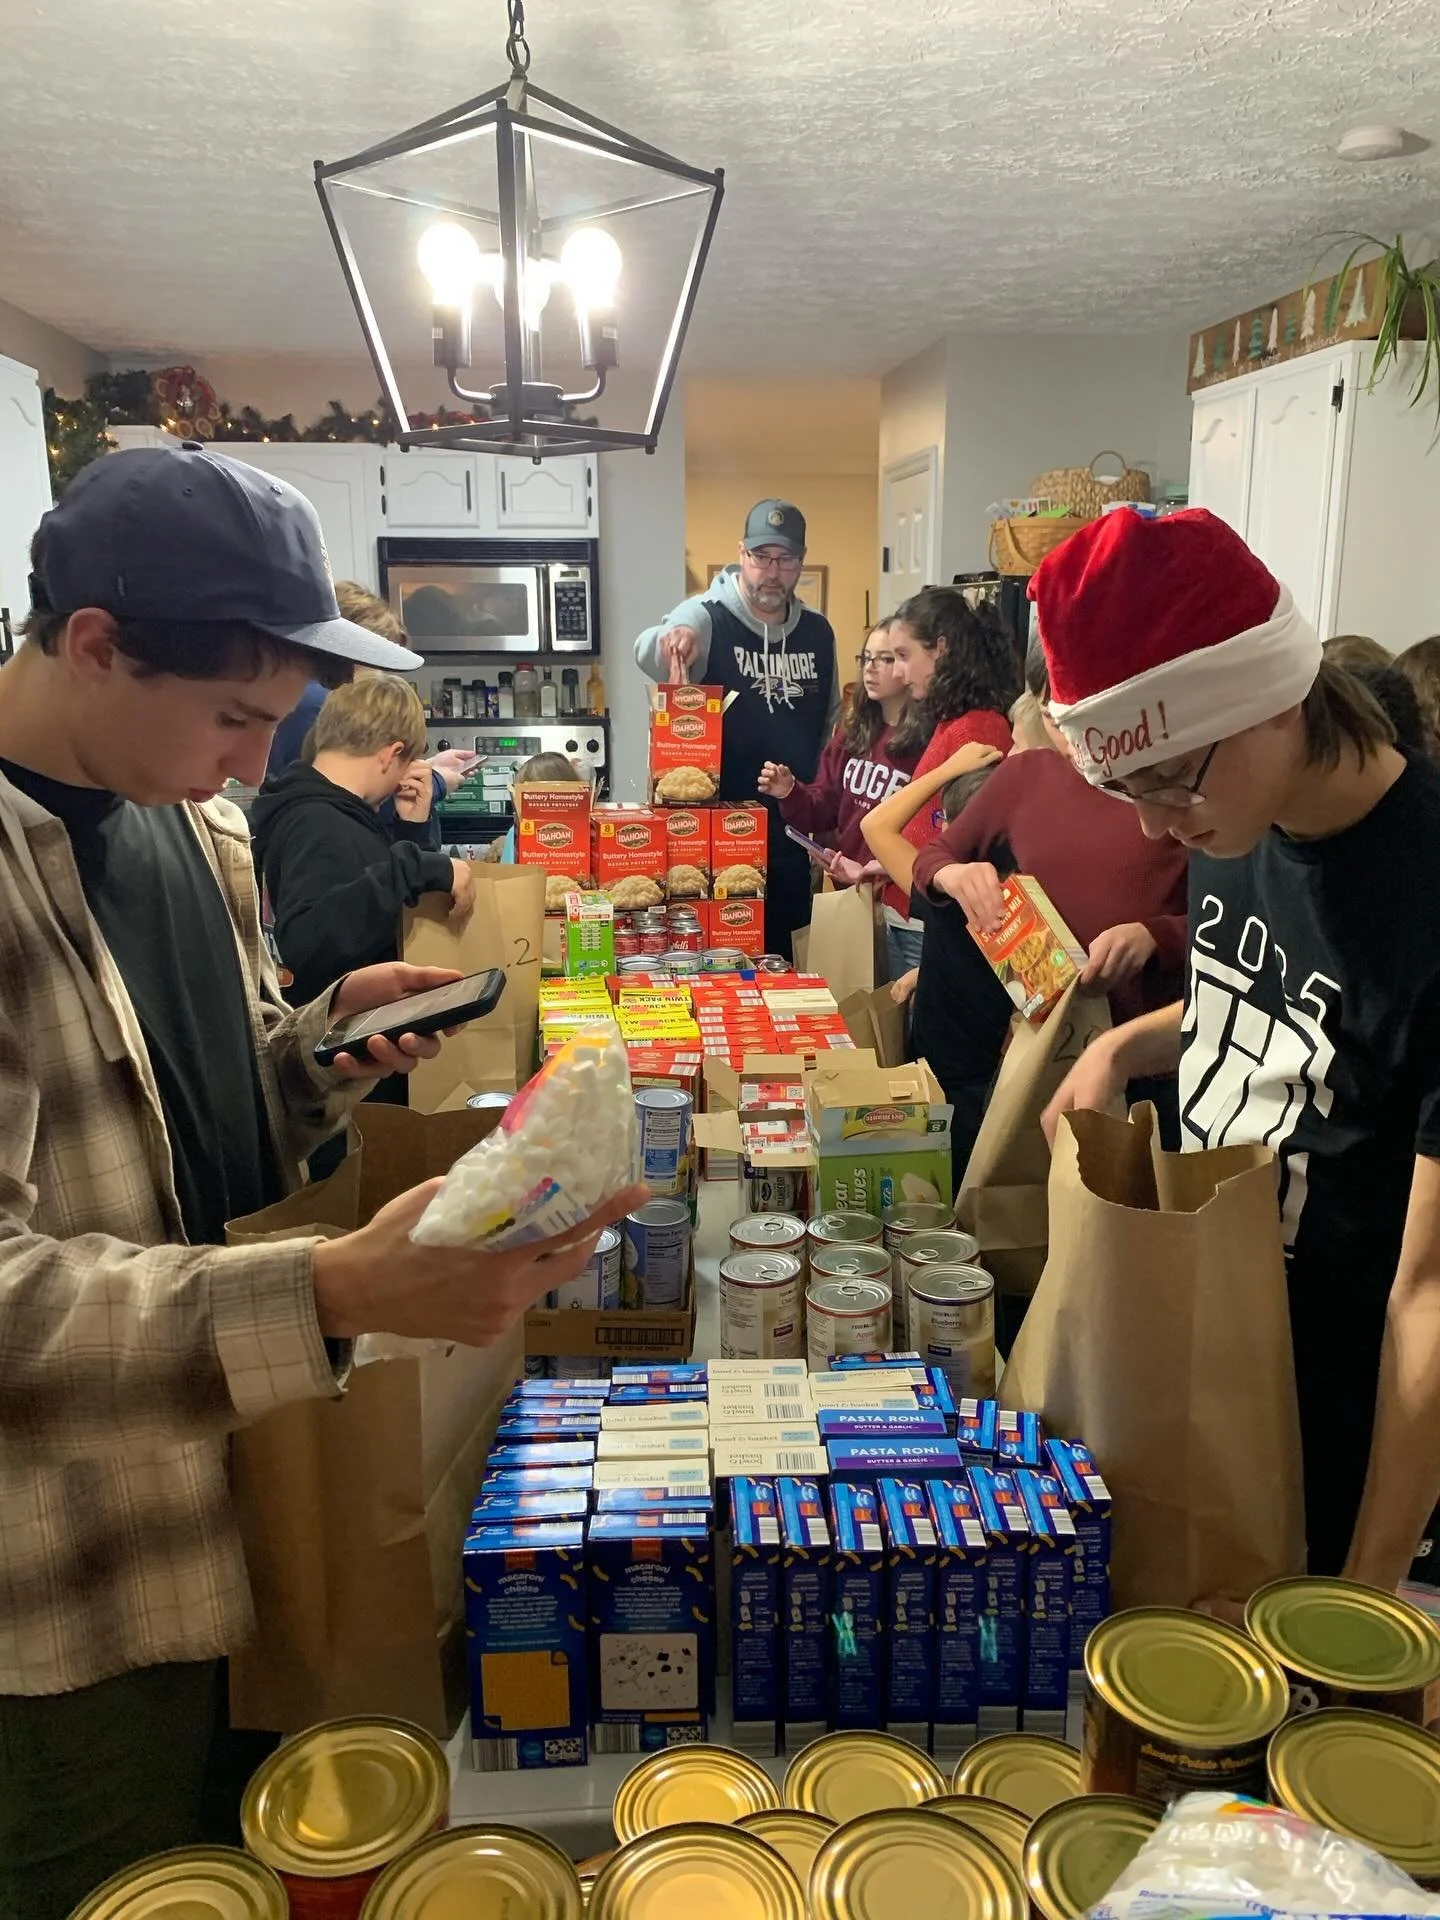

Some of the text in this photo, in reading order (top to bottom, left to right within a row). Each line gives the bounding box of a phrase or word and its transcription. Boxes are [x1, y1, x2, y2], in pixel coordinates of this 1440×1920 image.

[733, 646, 818, 680] BALTIMORE
[672, 723, 704, 732] IDAHOAN
[656, 741, 717, 751] Buttery Homestyle
[523, 792, 584, 802] Buttery Homestyle
[666, 820, 697, 830] IDAHOAN
[724, 819, 755, 830] IDAHOAN
[538, 831, 571, 842] IDAHOAN
[618, 831, 649, 843] IDAHOAN
[522, 851, 586, 860] Buttery Homestyle
[602, 850, 663, 861] Buttery Homestyle
[1009, 894, 1025, 914] MIX
[721, 911, 752, 921] IDAHOAN
[711, 929, 761, 938] Buttery Homestyle
[995, 915, 1023, 946] TURKEY
[835, 1179, 849, 1211] ear
[839, 1414, 925, 1423] PASTA RONI
[850, 1446, 940, 1457] PASTA RONI
[624, 1562, 672, 1575] macaroni
[497, 1572, 546, 1585] macaroni
[629, 1574, 665, 1584] cheese
[503, 1585, 540, 1595] cheese
